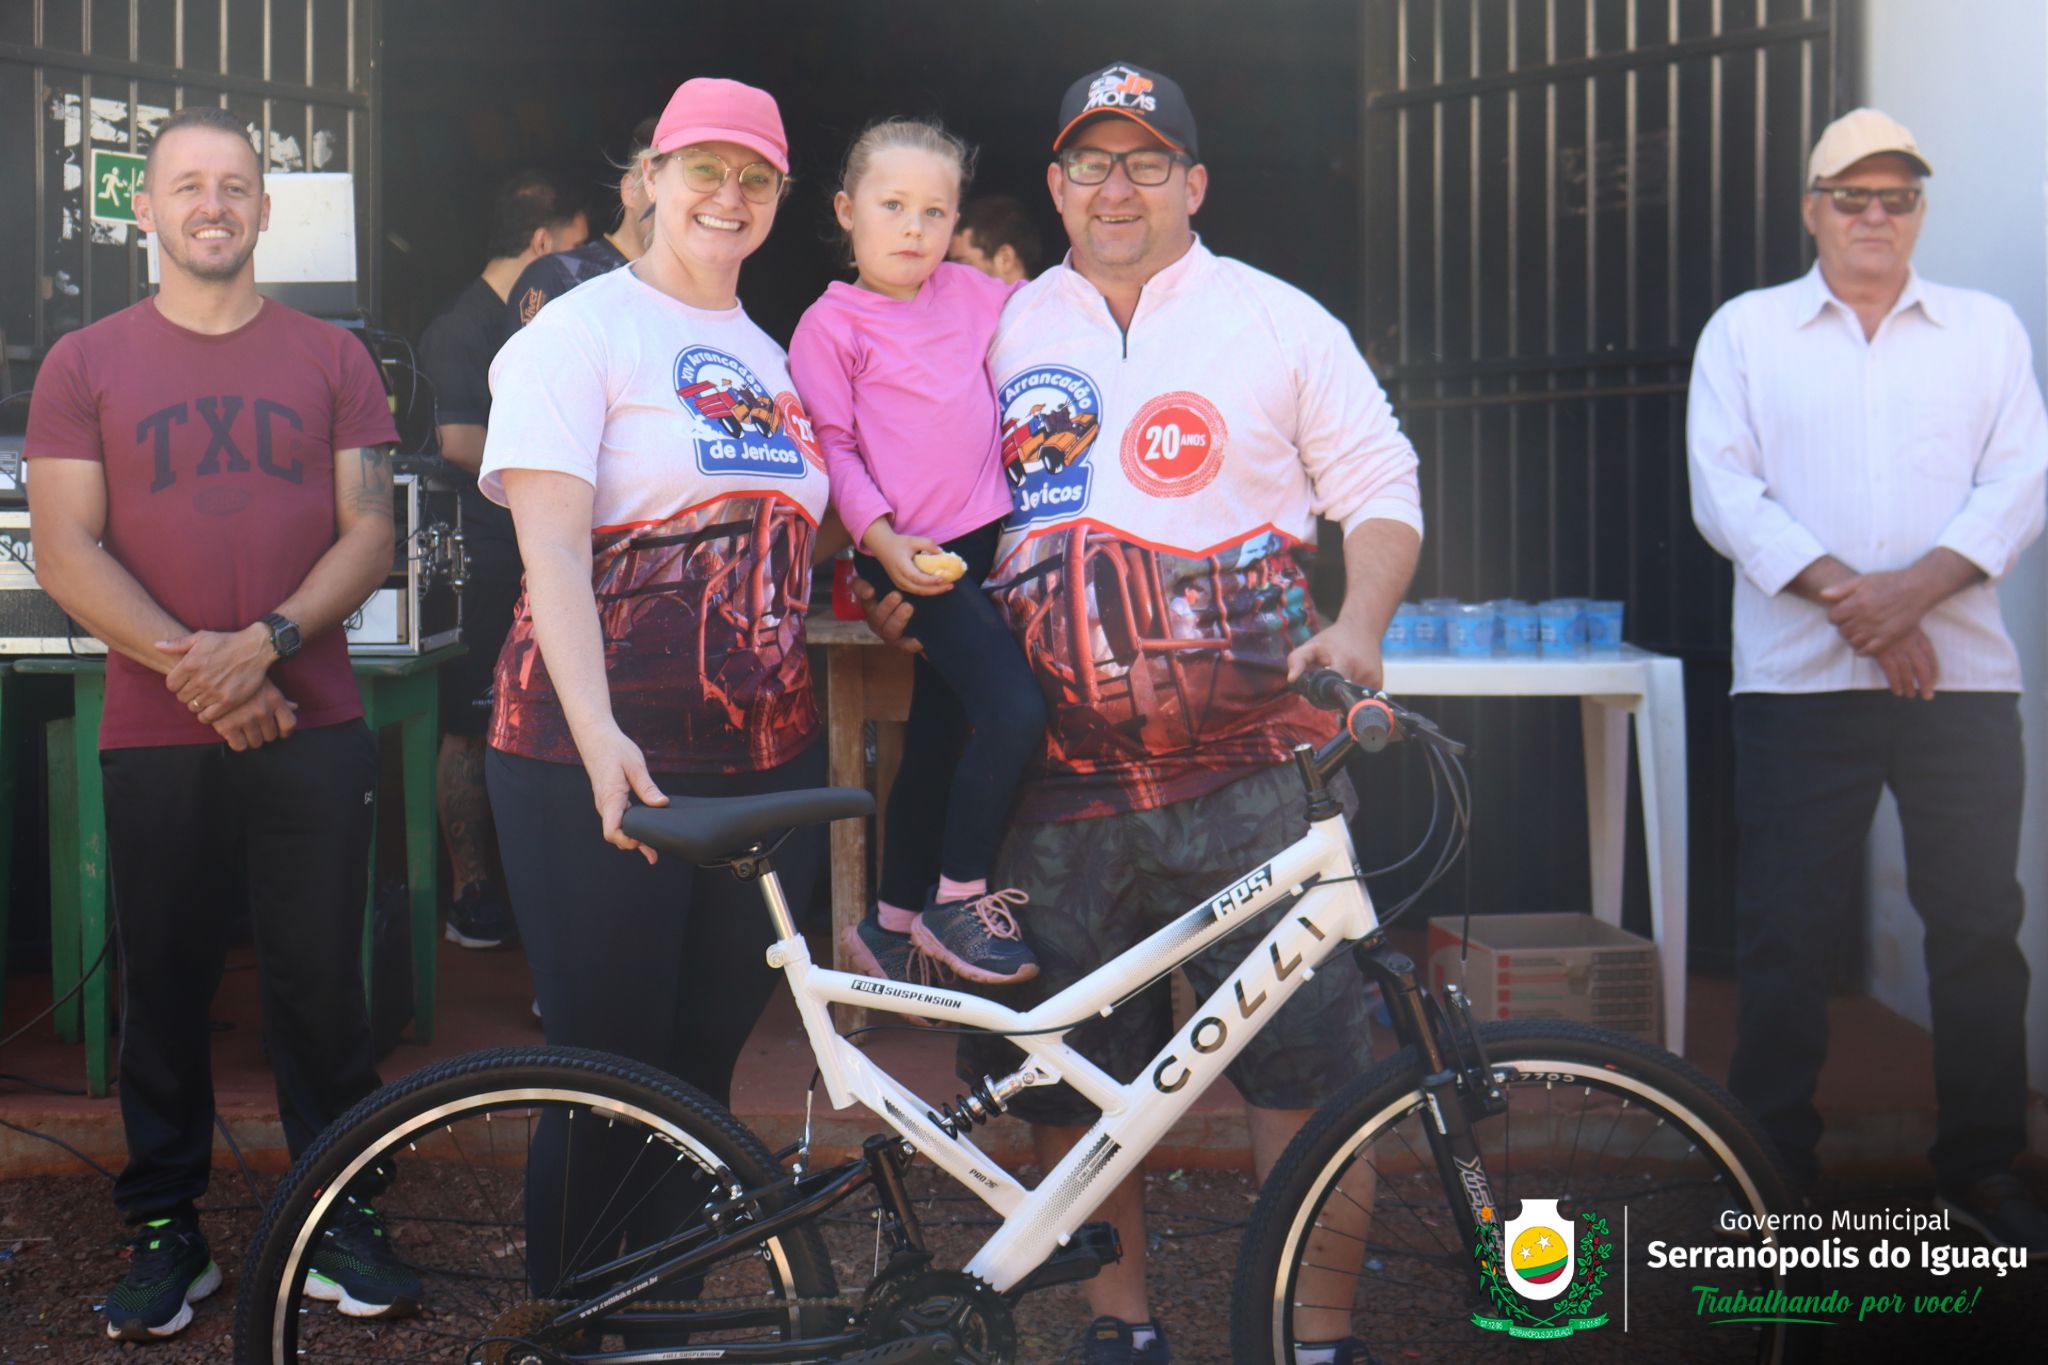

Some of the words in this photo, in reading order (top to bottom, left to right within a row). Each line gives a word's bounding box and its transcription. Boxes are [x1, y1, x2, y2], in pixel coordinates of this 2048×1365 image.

[1083, 91, 1156, 112] MOLAS
[136, 395, 303, 493] TXC
[710, 440, 736, 459] de
[741, 442, 798, 464] Jericos
[1144, 423, 1180, 461] 20
[1180, 433, 1206, 447] ANOS
[1020, 482, 1082, 512] Jeicos
[853, 980, 883, 995] FULL
[884, 986, 962, 1009] SUSPENSION
[1153, 916, 1326, 1094] COLLI
